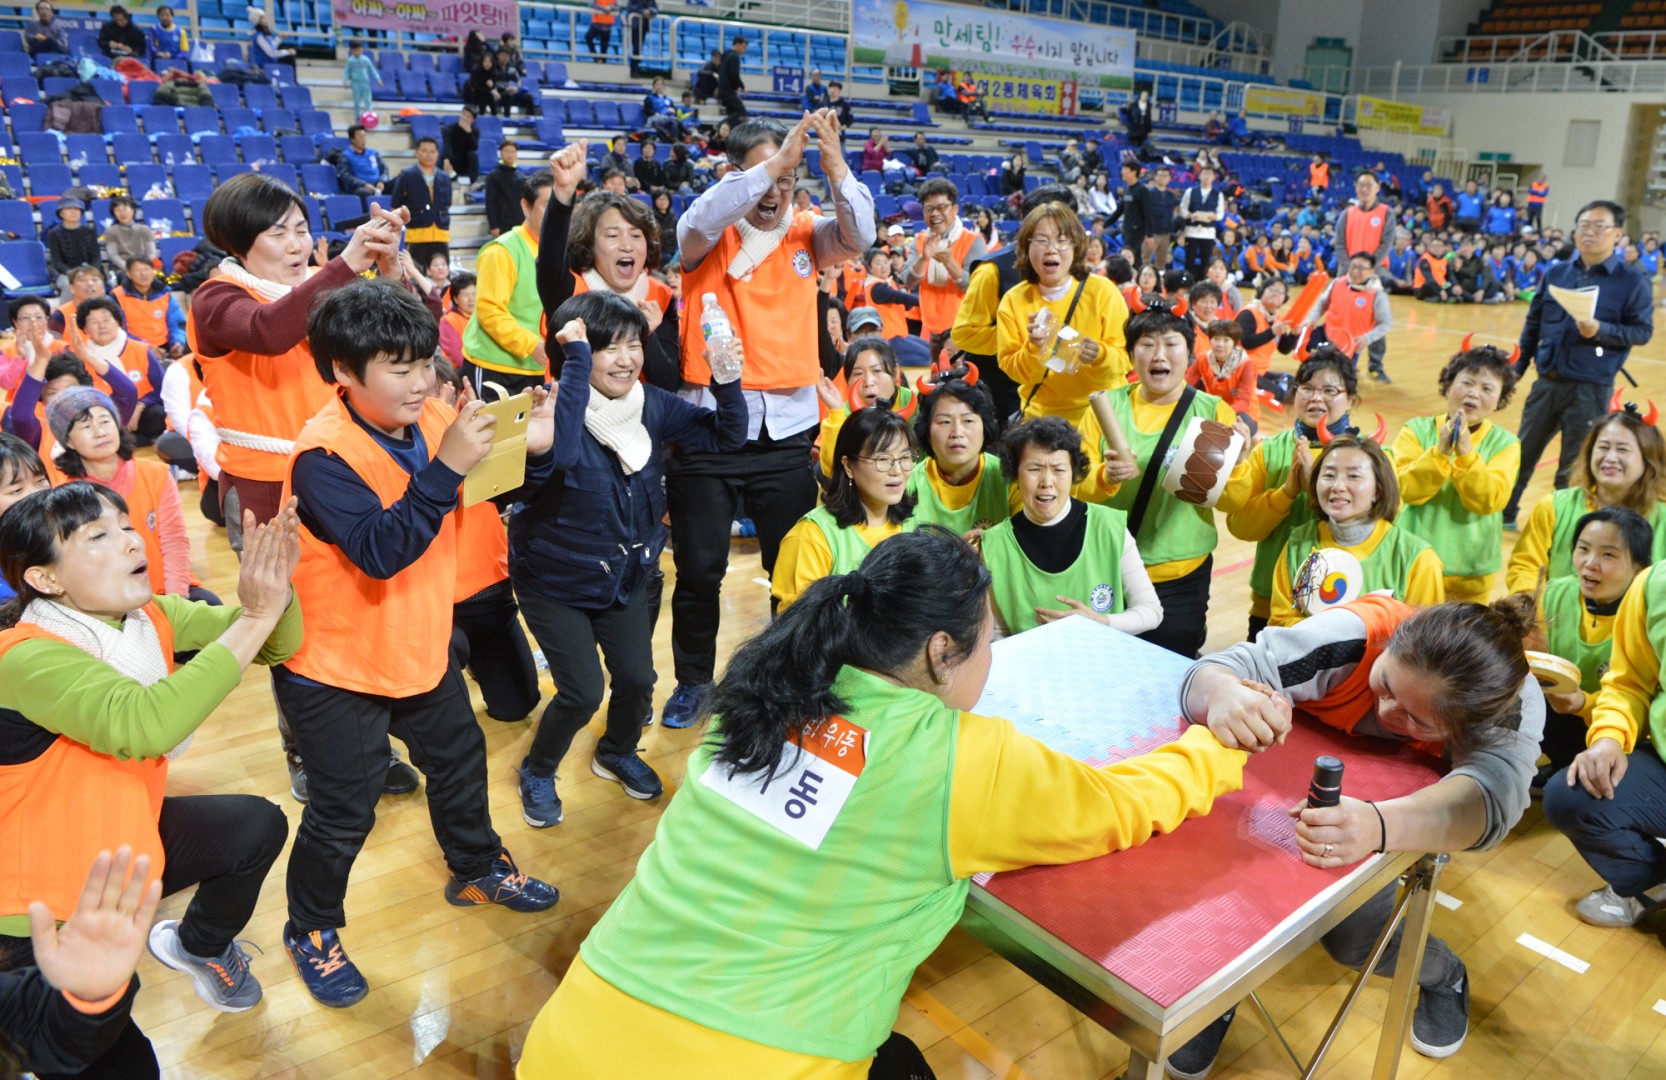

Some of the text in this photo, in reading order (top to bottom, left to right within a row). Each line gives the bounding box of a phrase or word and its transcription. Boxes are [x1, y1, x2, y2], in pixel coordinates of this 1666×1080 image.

[934, 18, 1119, 67] 만세팀! 우승이지 말입니다
[778, 78, 800, 92] 1-4
